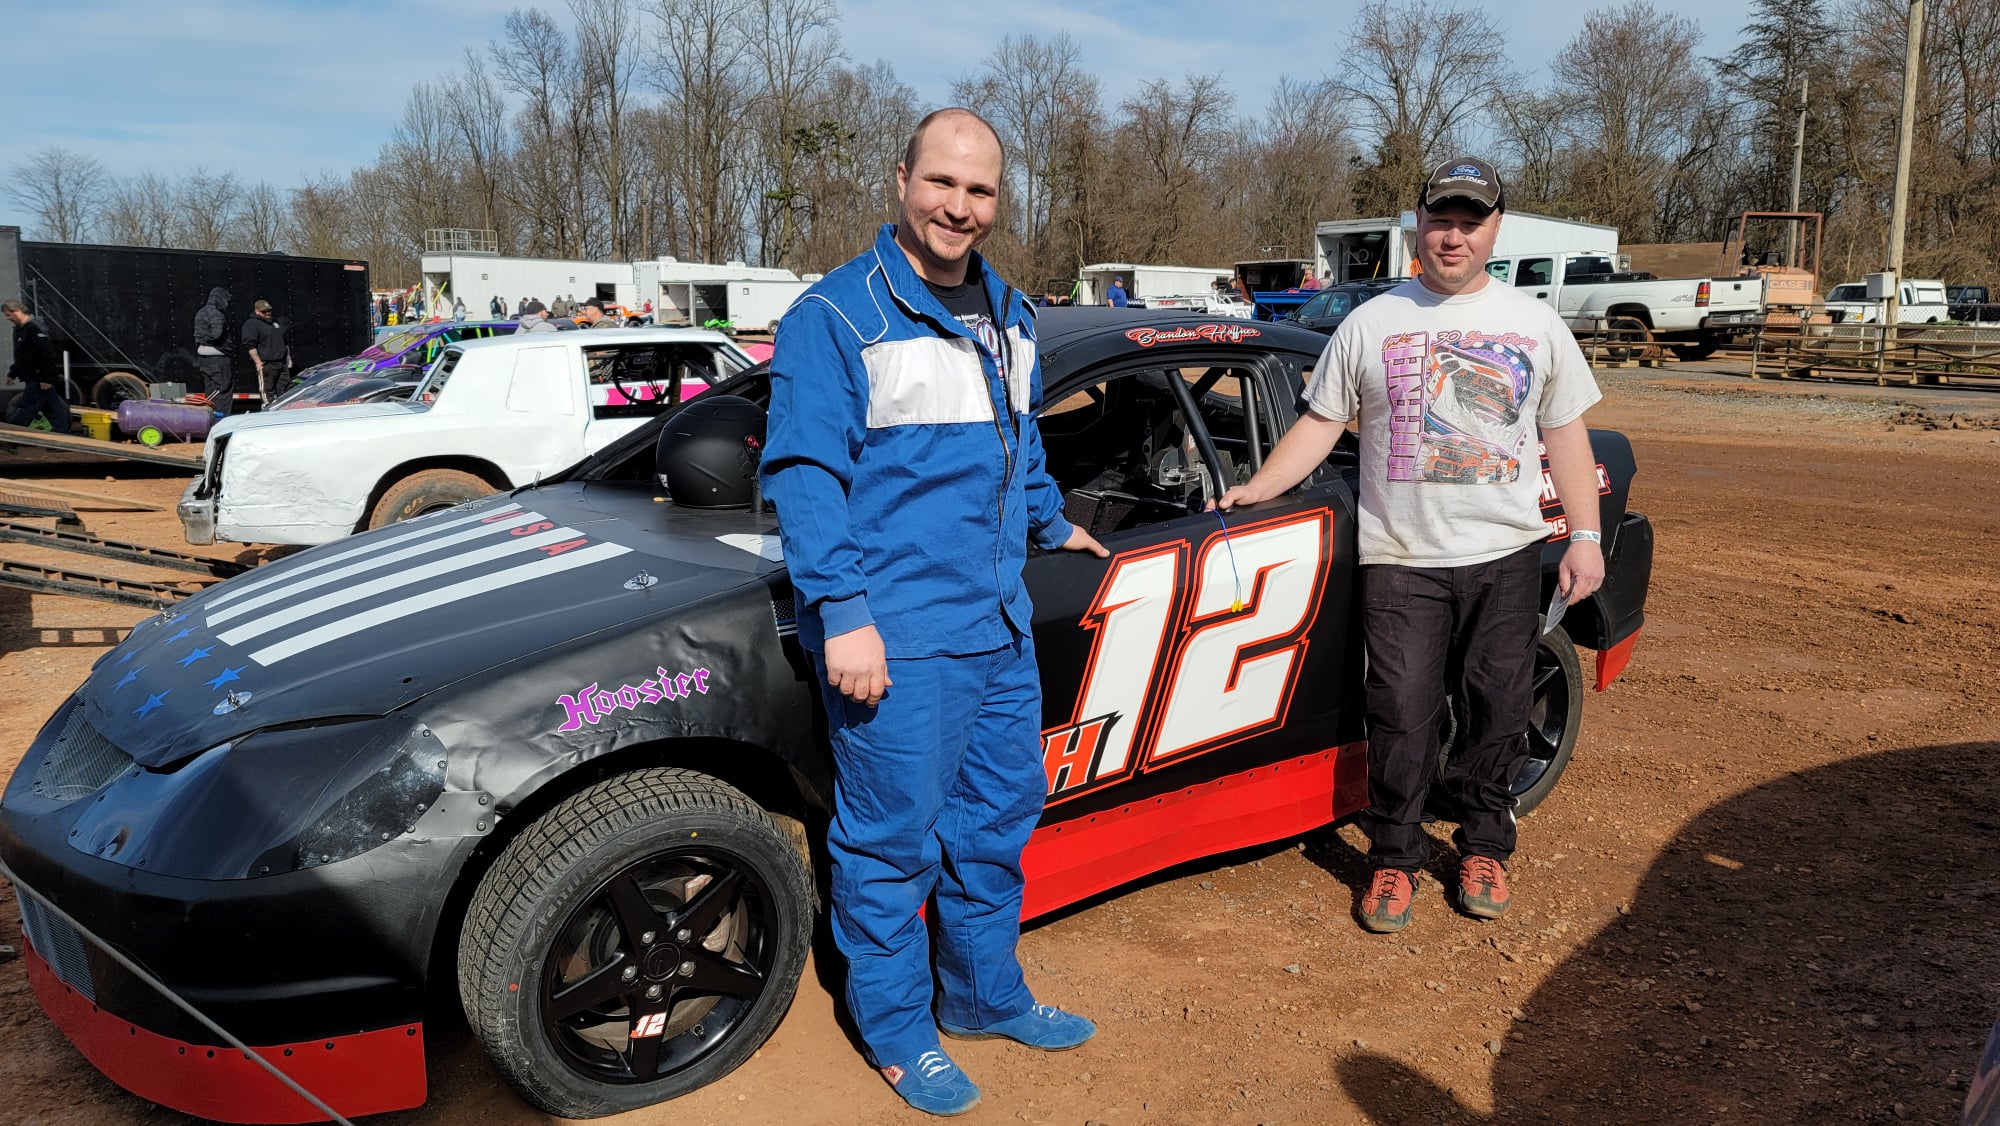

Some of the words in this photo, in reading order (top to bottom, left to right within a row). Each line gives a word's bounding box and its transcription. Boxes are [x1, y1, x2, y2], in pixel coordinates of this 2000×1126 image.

[1454, 165, 1476, 175] Ford
[1439, 175, 1489, 186] RACING
[1770, 280, 1806, 290] CASE
[1126, 327, 1199, 345] Brandon
[1198, 324, 1261, 342] Hoffner
[1434, 330, 1461, 346] 30
[1077, 509, 1329, 780] 12
[555, 666, 710, 733] Hoosier
[635, 1012, 667, 1037] 12
